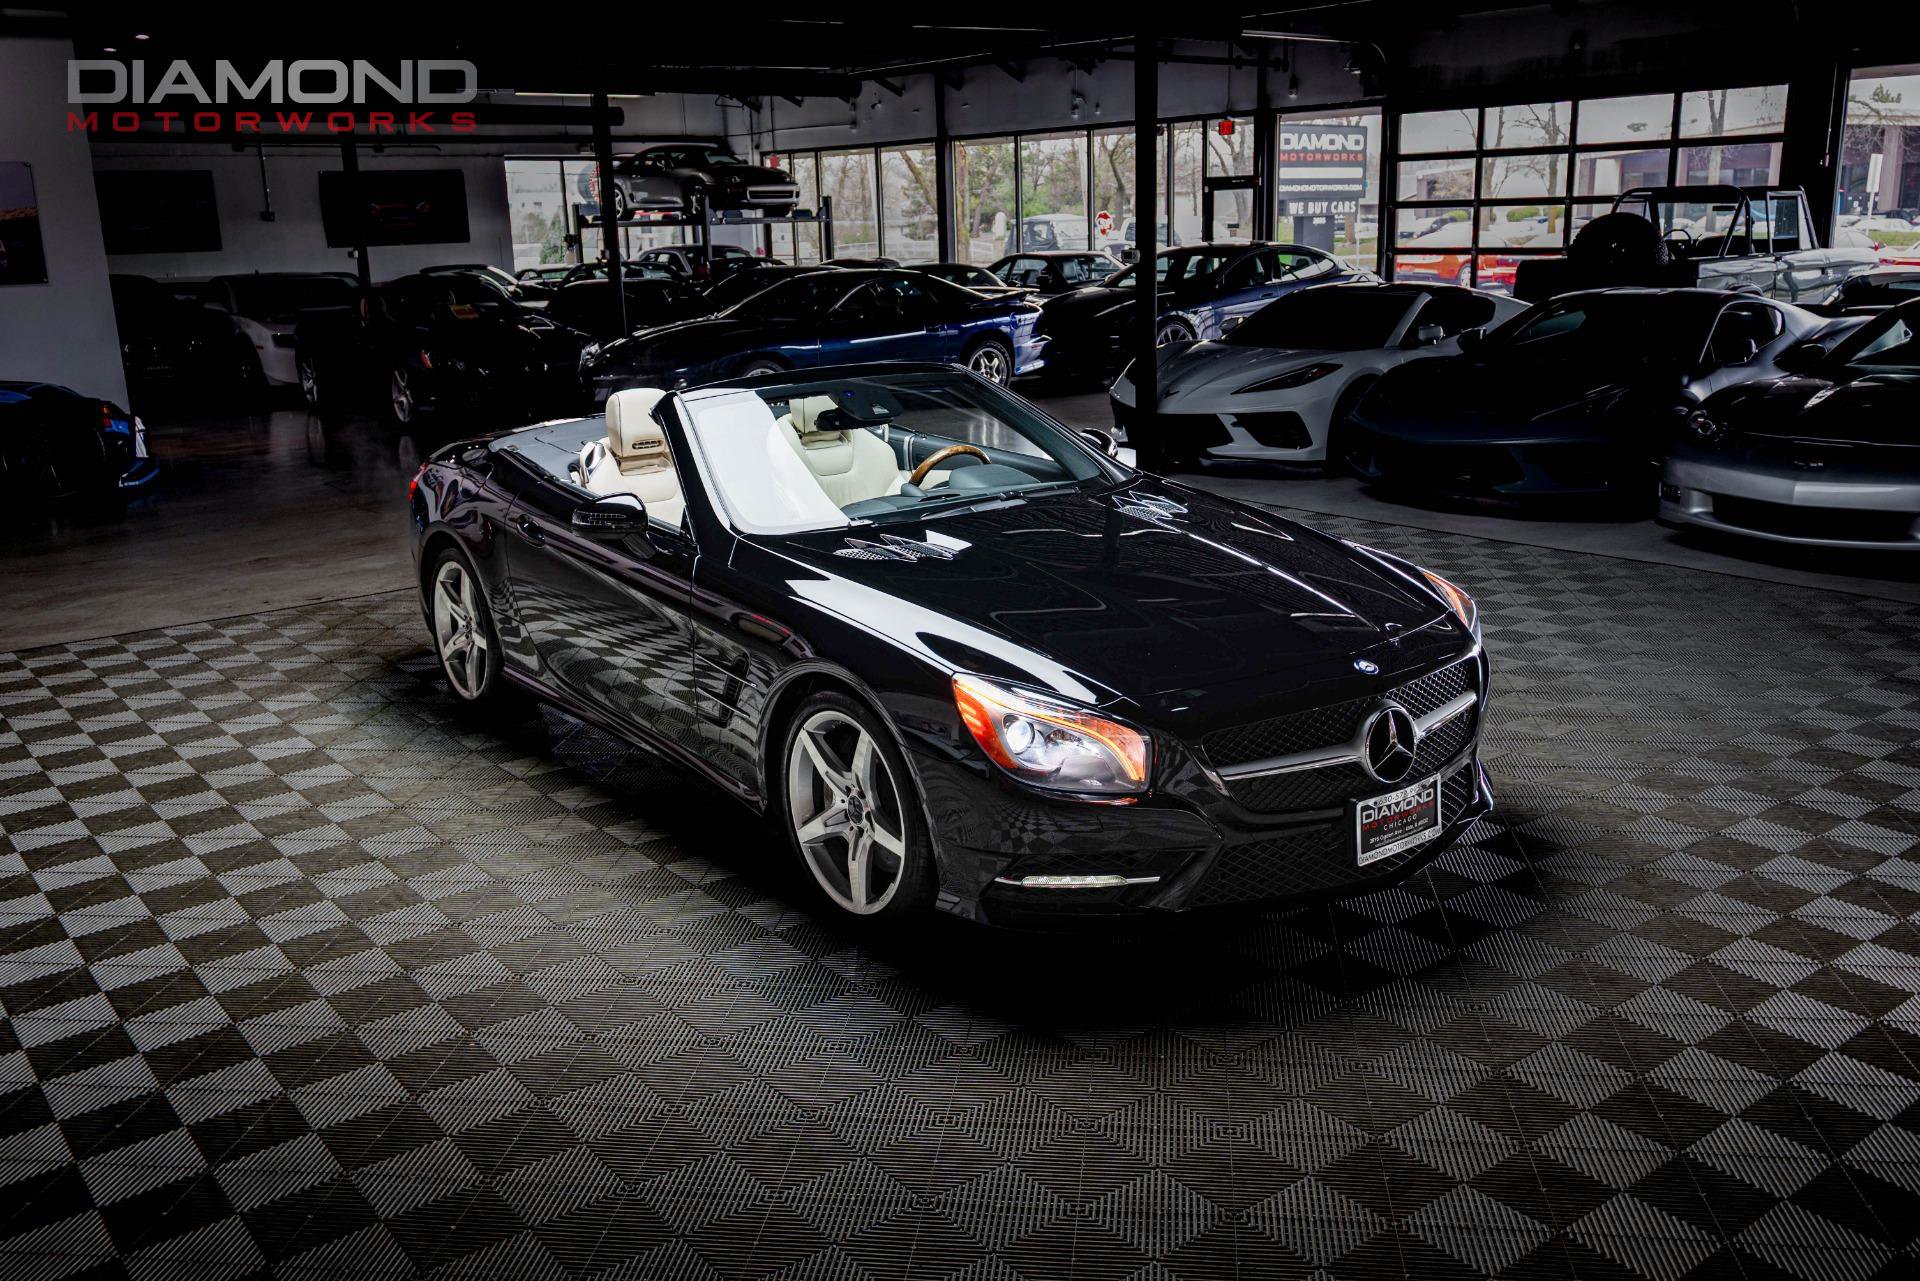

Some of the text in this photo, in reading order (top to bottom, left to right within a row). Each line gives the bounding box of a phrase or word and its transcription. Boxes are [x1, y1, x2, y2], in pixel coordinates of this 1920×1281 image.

[1280, 133, 1364, 150] DIAMOND
[1280, 152, 1364, 161] MOTORWORKS
[1289, 201, 1356, 214] WE BUY CARS
[1362, 788, 1434, 824] DIAMOND
[1362, 800, 1435, 832] MOTORWORKS
[1383, 814, 1417, 831] CHICAGO
